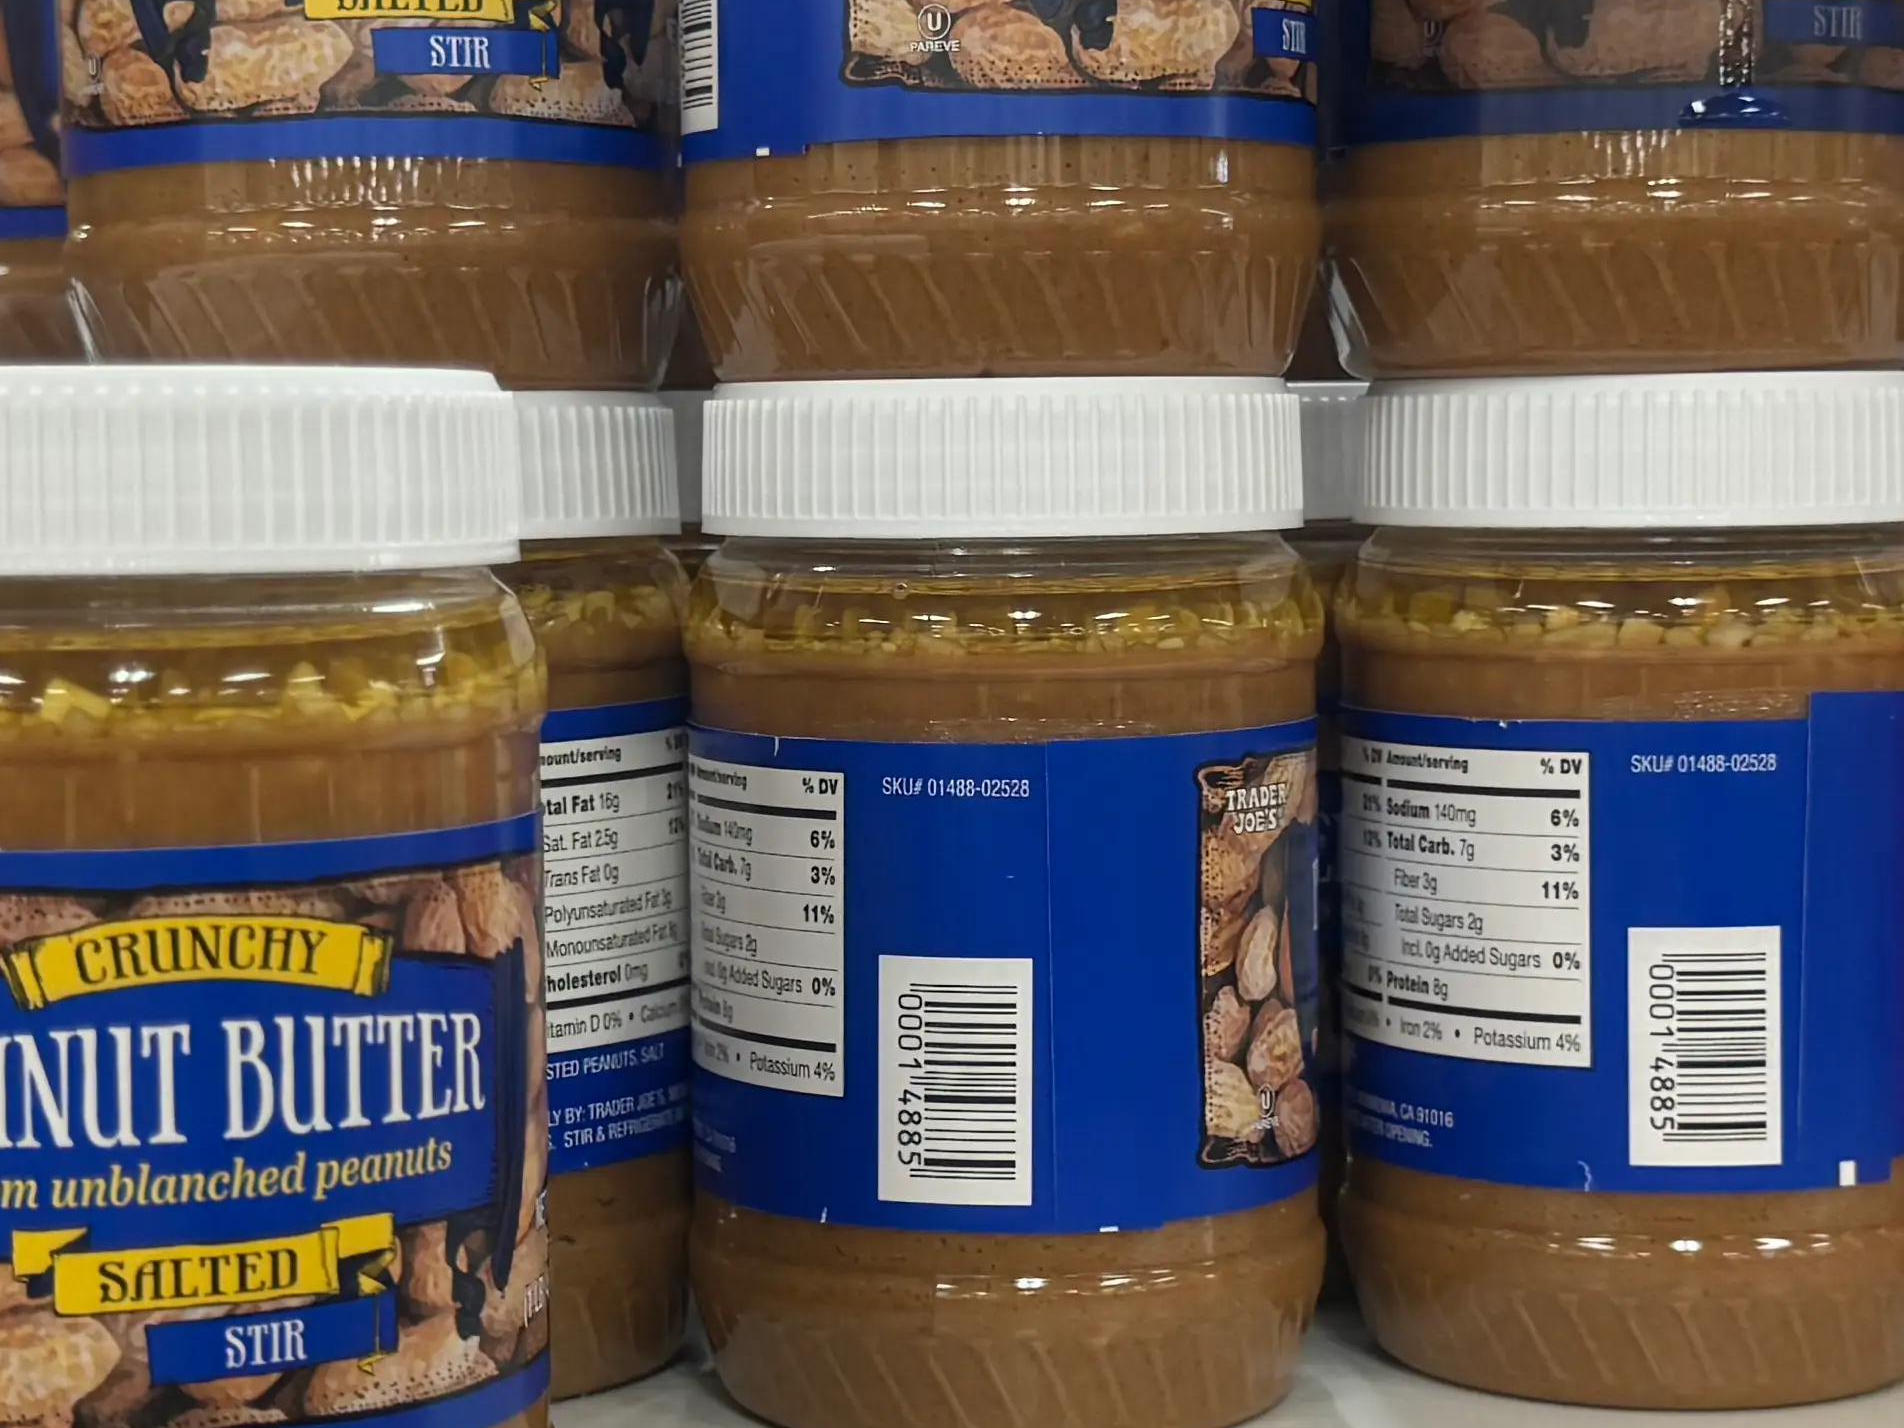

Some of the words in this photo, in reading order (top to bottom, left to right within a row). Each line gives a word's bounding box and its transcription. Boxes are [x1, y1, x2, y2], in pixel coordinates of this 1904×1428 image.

[1812, 5, 1863, 39] STIR
[429, 36, 491, 70] STIR
[910, 39, 960, 52] PAREVE
[1630, 754, 1673, 773] SKU#
[1677, 753, 1777, 773] 01488-02528
[881, 777, 923, 797] SKU#
[927, 778, 1030, 798] 01488-02528
[1226, 788, 1287, 812] TRADER
[809, 830, 835, 850] 6%
[809, 867, 835, 886] 3%
[802, 905, 835, 924] 11%
[74, 925, 327, 986] CRUNCHY
[1473, 1027, 1551, 1051] Potassium
[1648, 963, 1675, 1132] 00014885
[223, 1012, 486, 1140] BUTTER
[898, 992, 923, 1168] 00014885
[51, 1152, 305, 1209] unblanched
[315, 1137, 452, 1199] peanuts
[98, 1250, 297, 1303] SALTED
[224, 1319, 307, 1370] STIR
